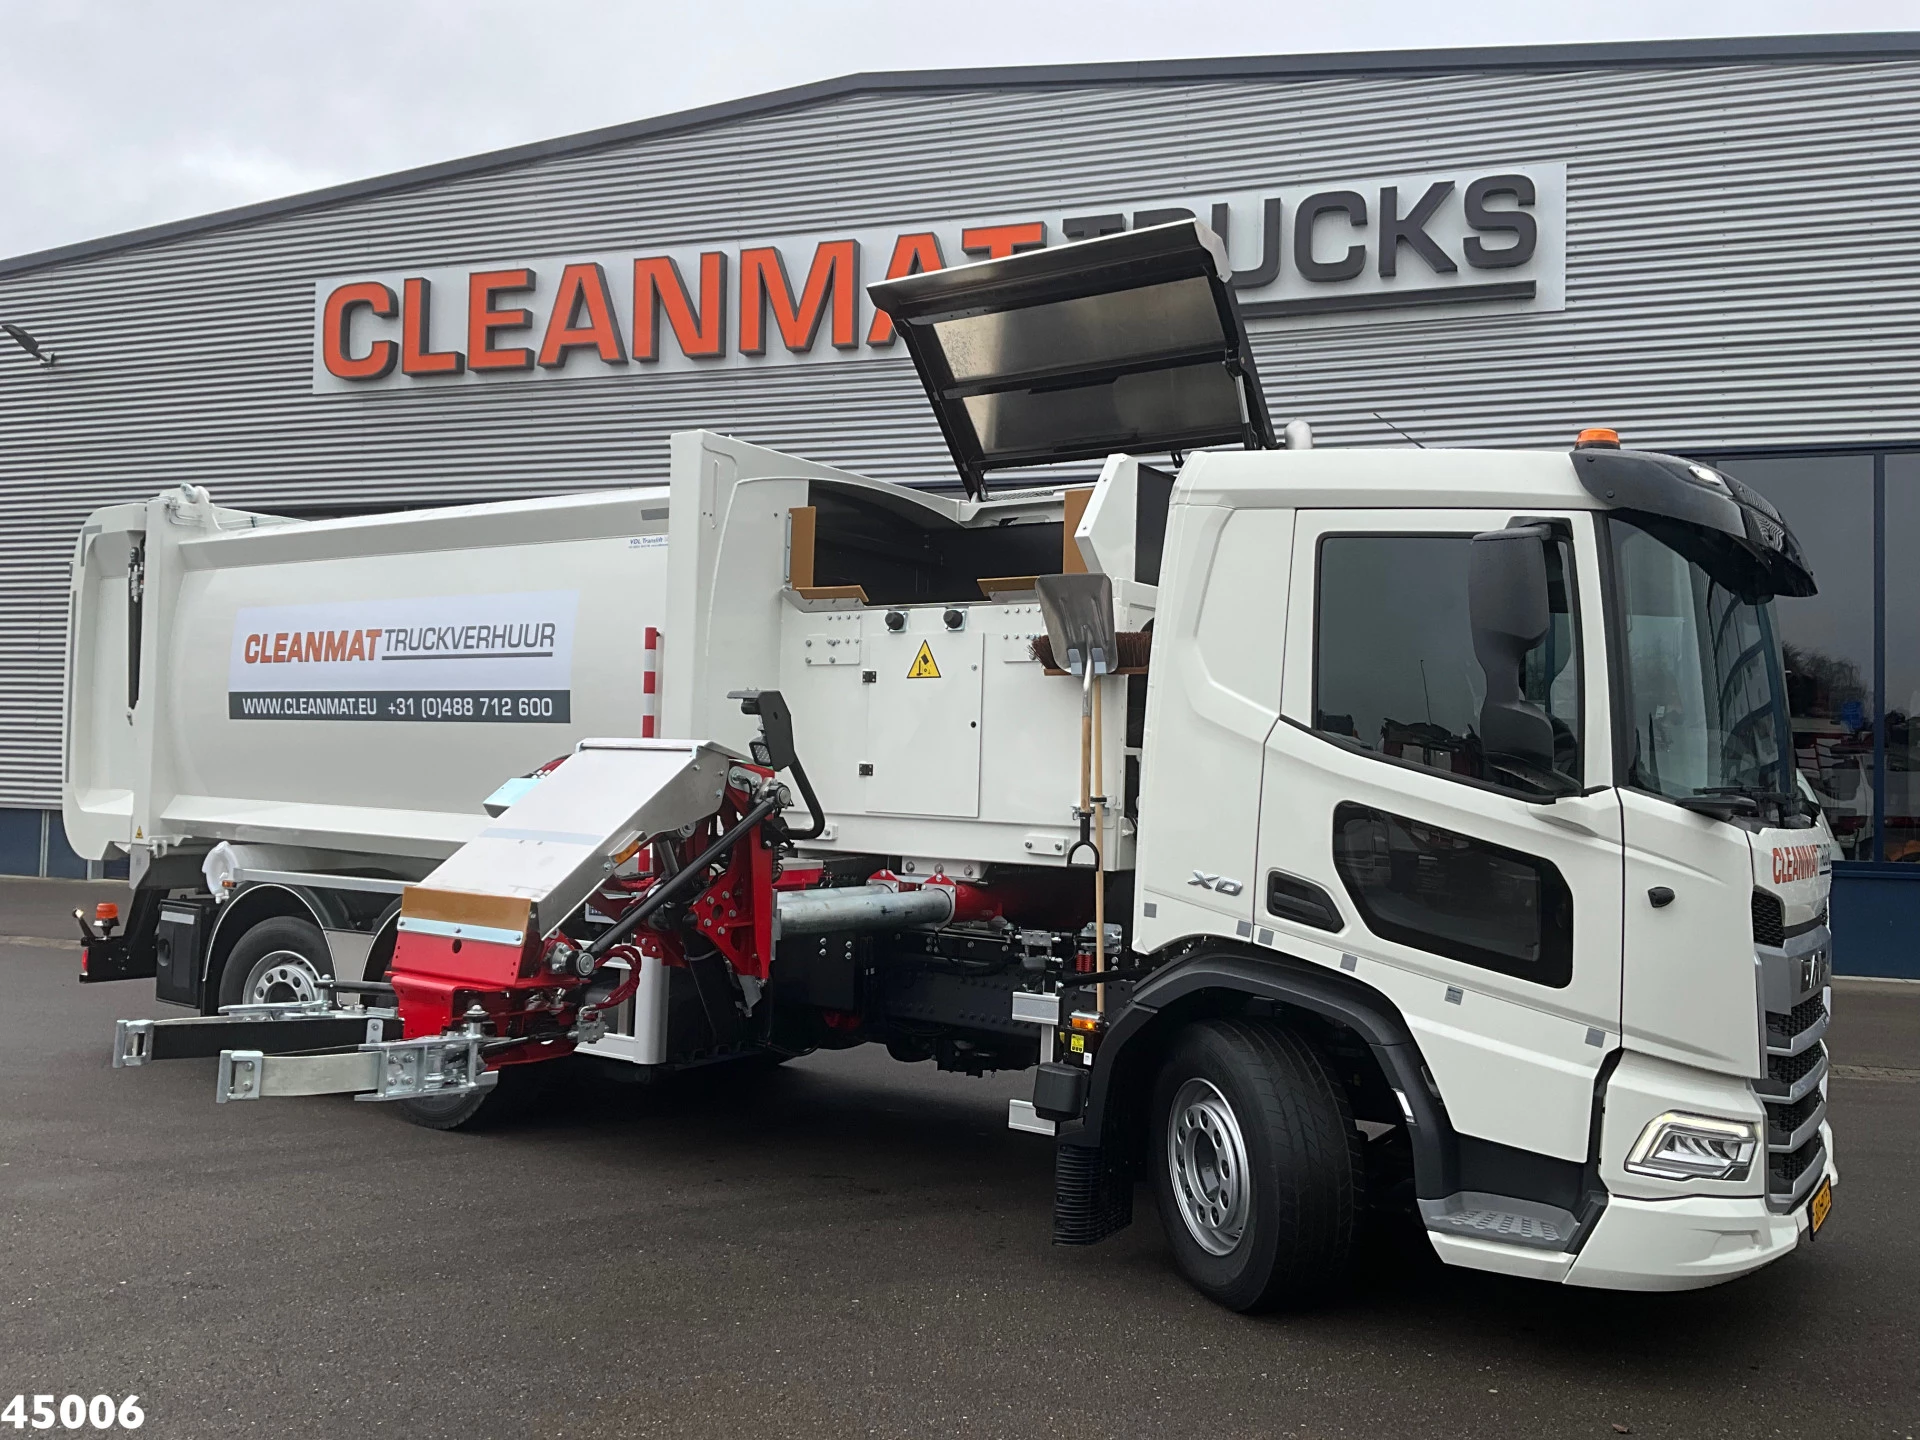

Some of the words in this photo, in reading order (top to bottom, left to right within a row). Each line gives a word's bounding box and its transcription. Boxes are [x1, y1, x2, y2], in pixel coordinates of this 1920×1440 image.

[244, 628, 383, 664] CLEANMAT
[383, 622, 556, 652] TRUCKVERHUUR
[242, 697, 377, 715] WWW.CLEANMAT.EU
[387, 698, 415, 716] +31
[421, 697, 474, 719] (0)488
[480, 698, 512, 717] 712
[518, 697, 553, 717] 600
[1187, 869, 1244, 897] XD
